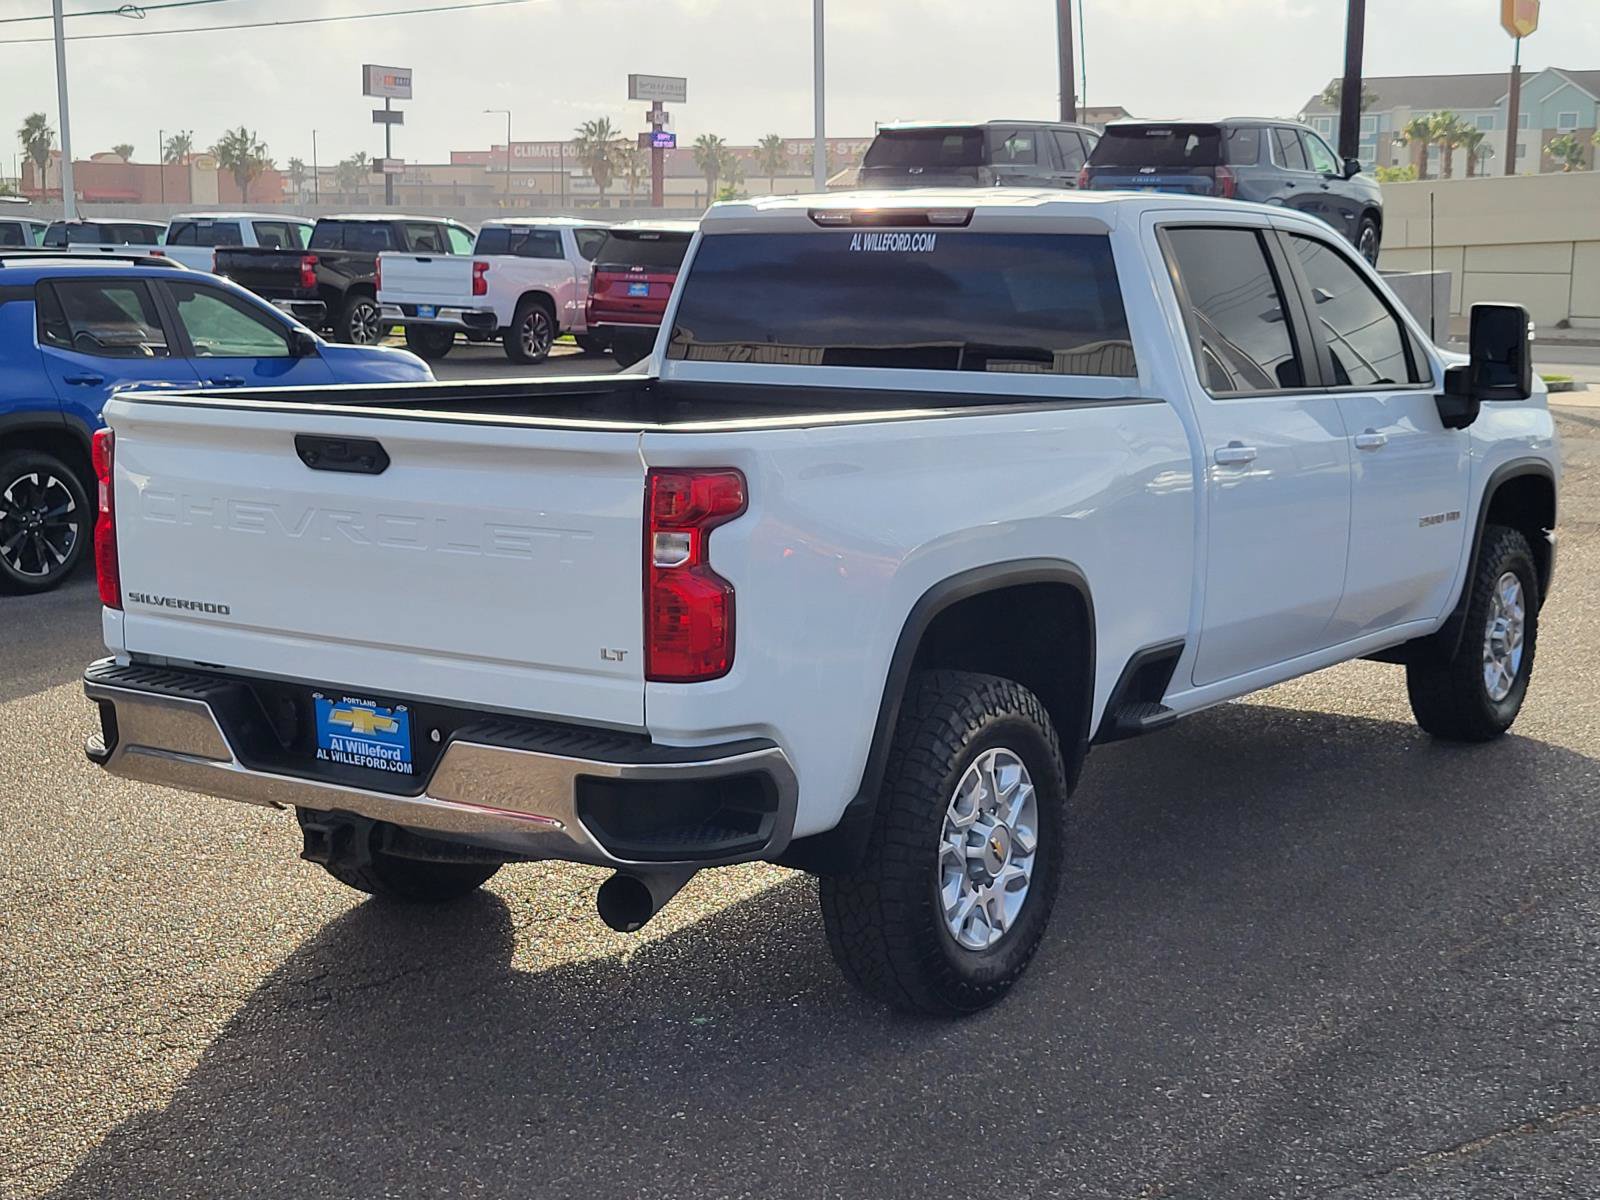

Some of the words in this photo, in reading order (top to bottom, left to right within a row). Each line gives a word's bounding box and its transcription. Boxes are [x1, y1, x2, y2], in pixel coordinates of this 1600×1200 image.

[514, 144, 560, 157] CLIMATE
[850, 233, 861, 251] AL
[863, 233, 937, 252] WILLEFORD.COM
[141, 488, 595, 564] CHEVROLET
[128, 591, 231, 616] SILVERADO
[600, 647, 628, 662] LT
[342, 696, 377, 708] PORTLAND
[330, 738, 344, 751] Al
[345, 740, 401, 760] Willeford
[316, 748, 329, 760] AL
[331, 750, 413, 775] WILLEFORD.COM
